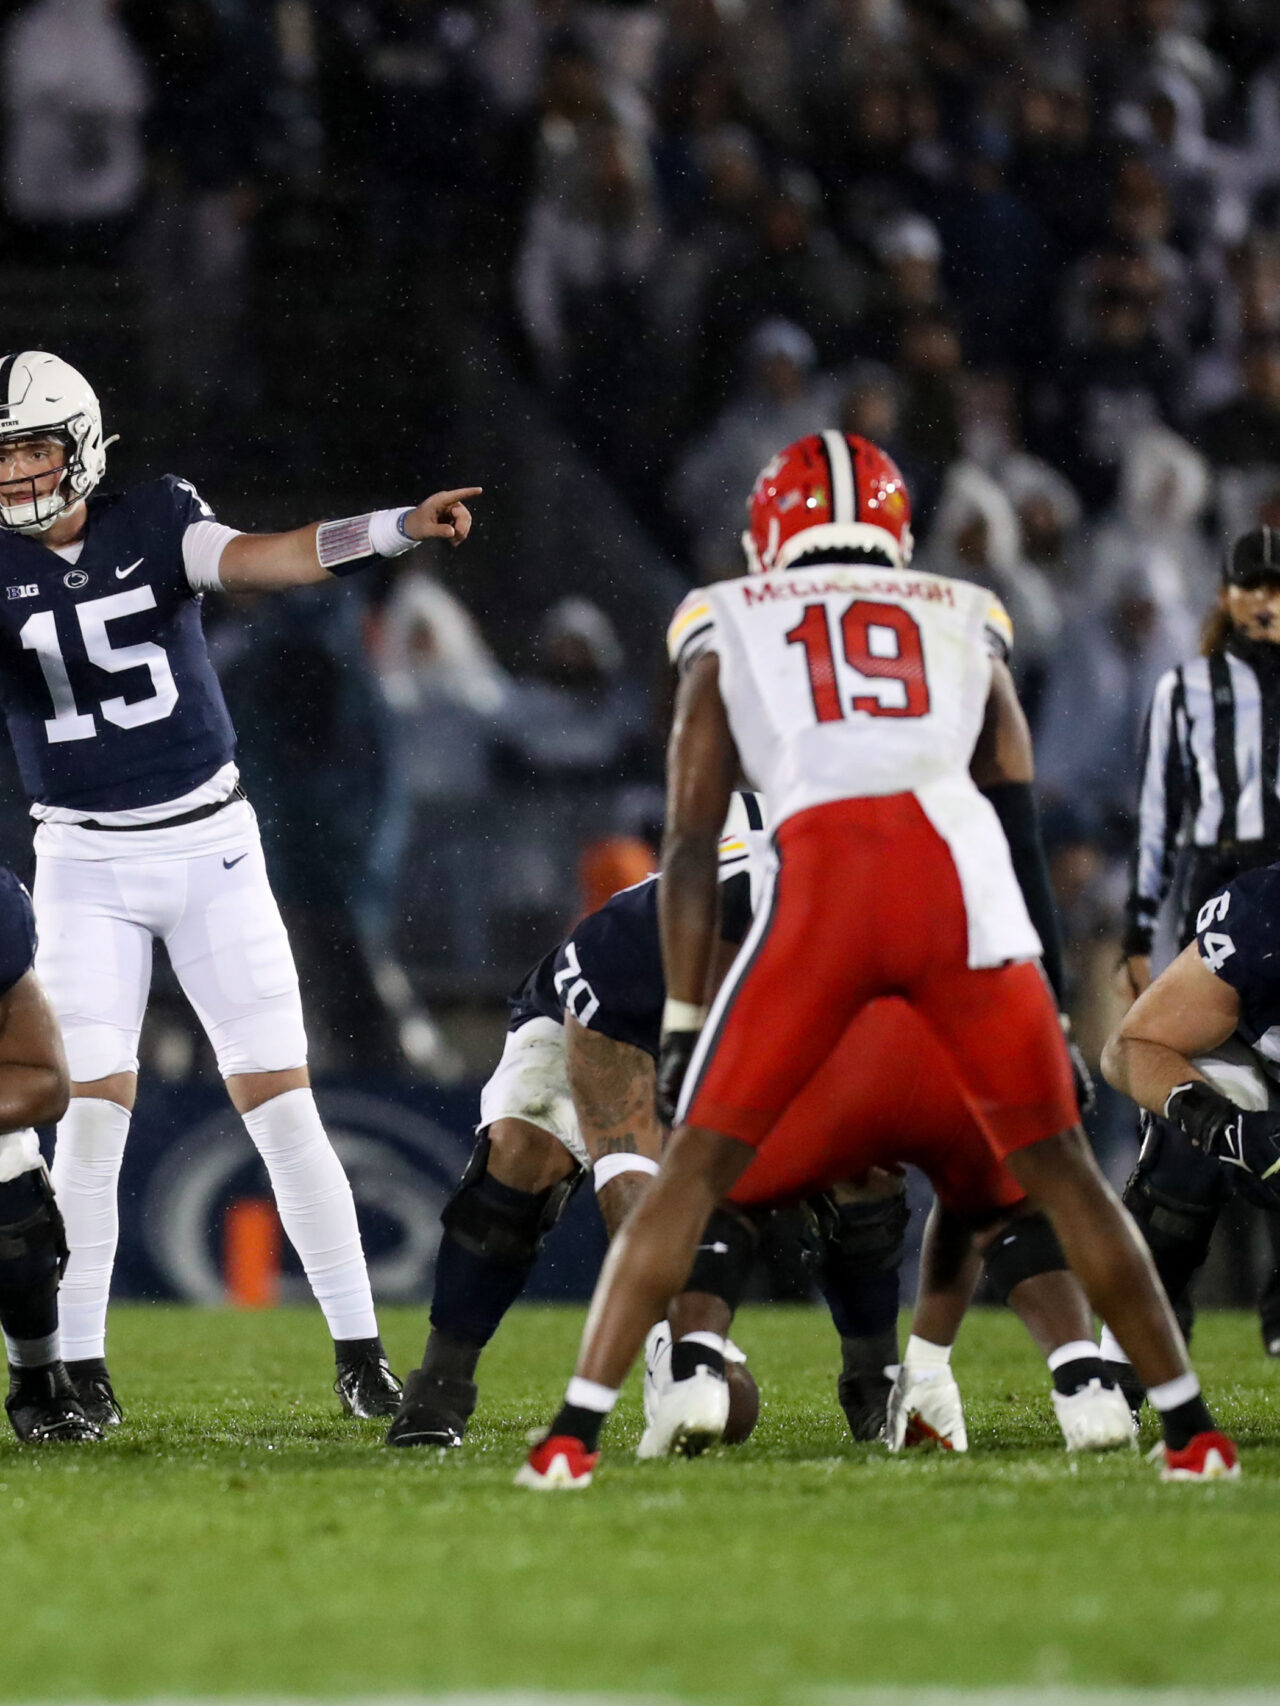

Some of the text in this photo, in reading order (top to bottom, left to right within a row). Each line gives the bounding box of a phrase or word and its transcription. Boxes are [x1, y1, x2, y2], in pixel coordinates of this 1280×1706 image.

[20, 584, 180, 744] 15
[785, 599, 931, 723] 19
[553, 941, 600, 1028] 70
[1196, 890, 1237, 974] 64
